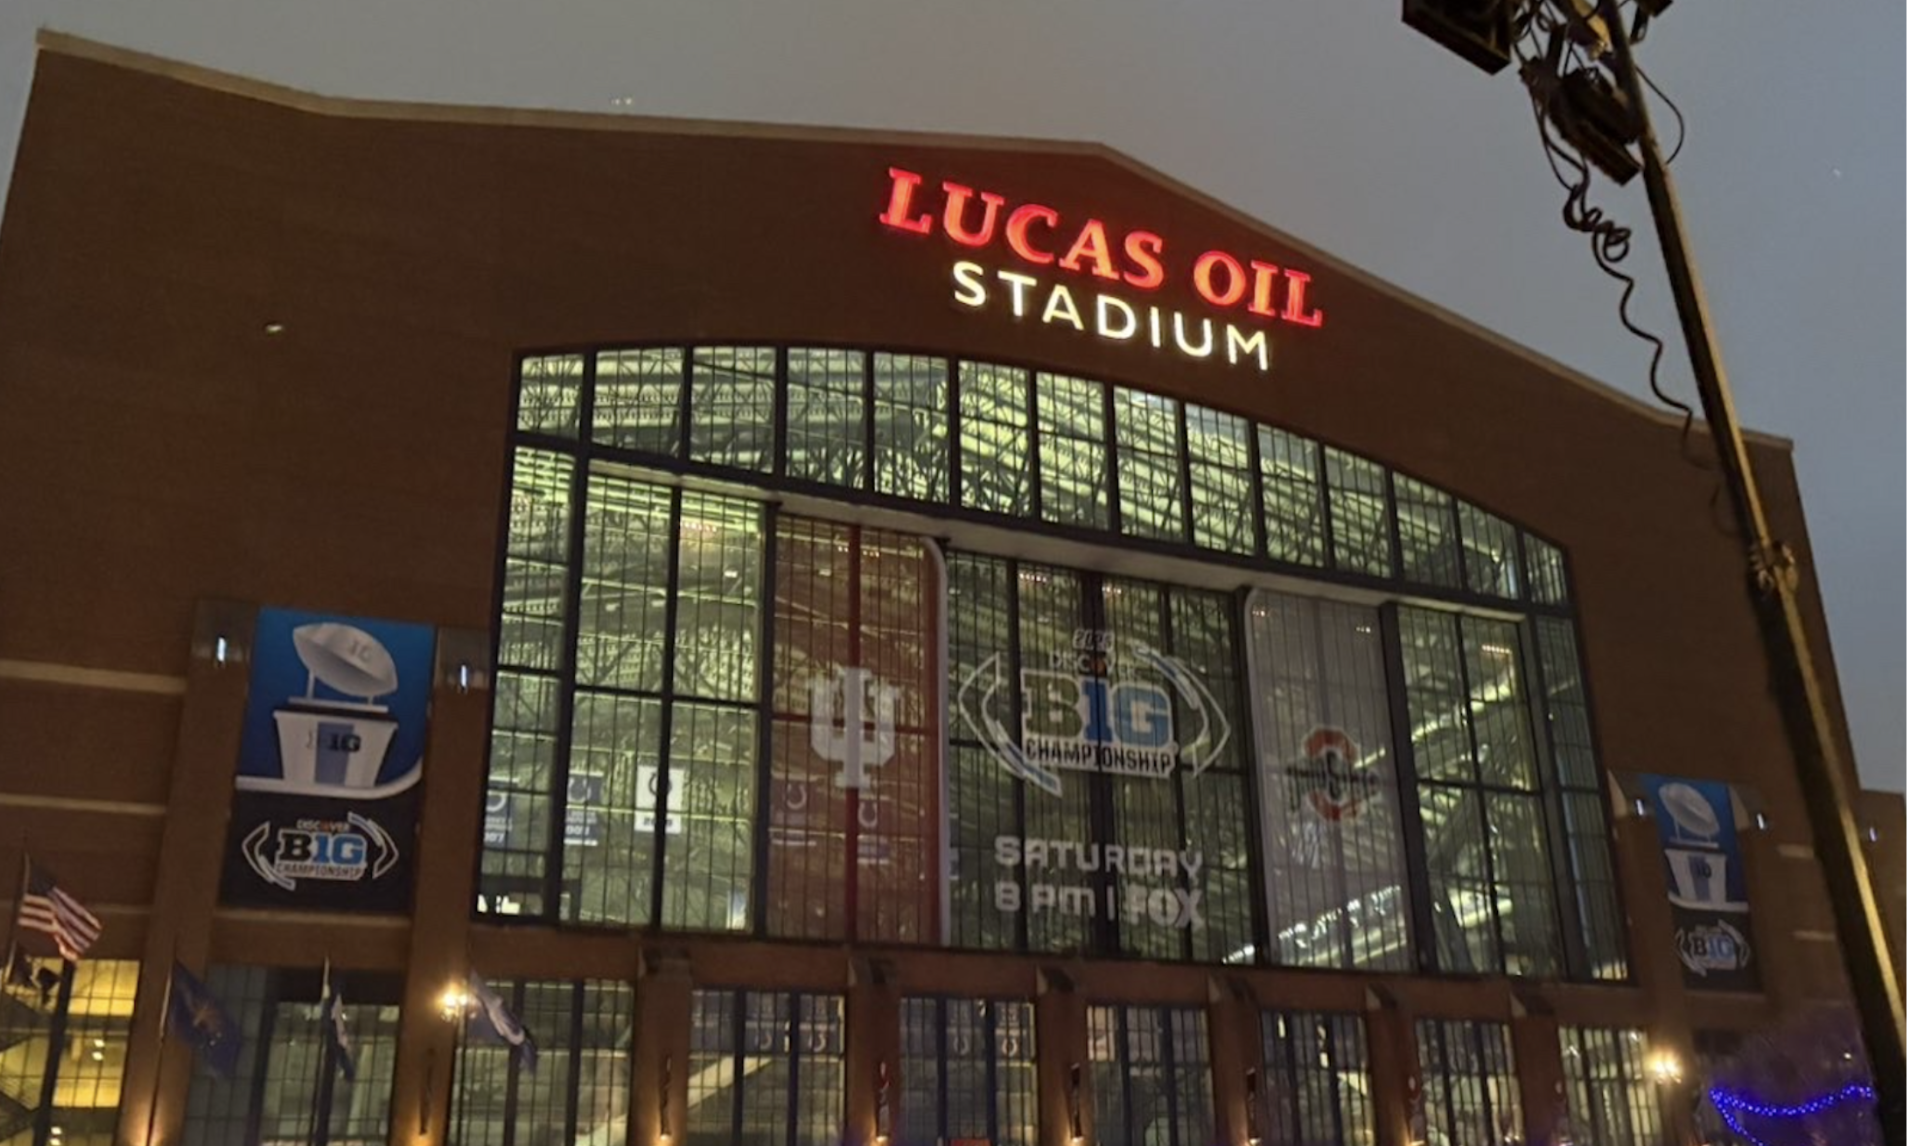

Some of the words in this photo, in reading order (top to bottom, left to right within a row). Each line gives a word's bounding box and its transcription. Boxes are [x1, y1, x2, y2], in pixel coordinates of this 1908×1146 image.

[879, 167, 1164, 290] LUCAS
[1193, 250, 1323, 328] OIL
[952, 261, 1269, 371] STADIUM
[1025, 738, 1172, 774] CHAMPIONSHIP
[275, 862, 364, 878] CHAMPIONSHIP
[995, 835, 1203, 881] SATURDAY
[995, 881, 1020, 912] 8
[1031, 884, 1096, 918] PM
[1125, 884, 1203, 929] FOX
